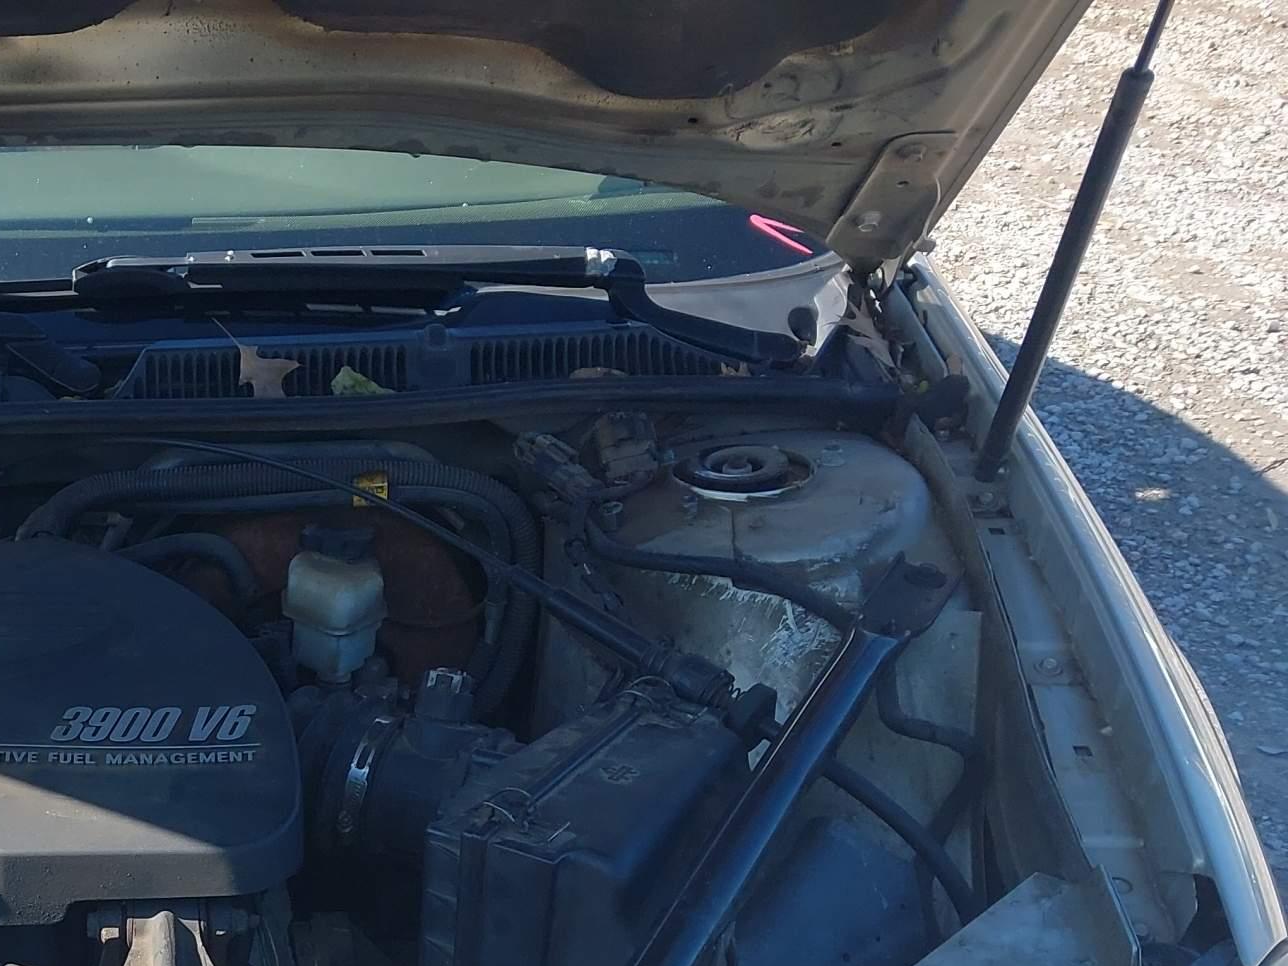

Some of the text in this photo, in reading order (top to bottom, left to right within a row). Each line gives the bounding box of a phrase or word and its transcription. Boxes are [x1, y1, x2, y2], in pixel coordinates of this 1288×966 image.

[51, 704, 256, 742] 3900 V6
[48, 752, 95, 764] FUEL
[105, 751, 256, 766] MANAGEMENT
